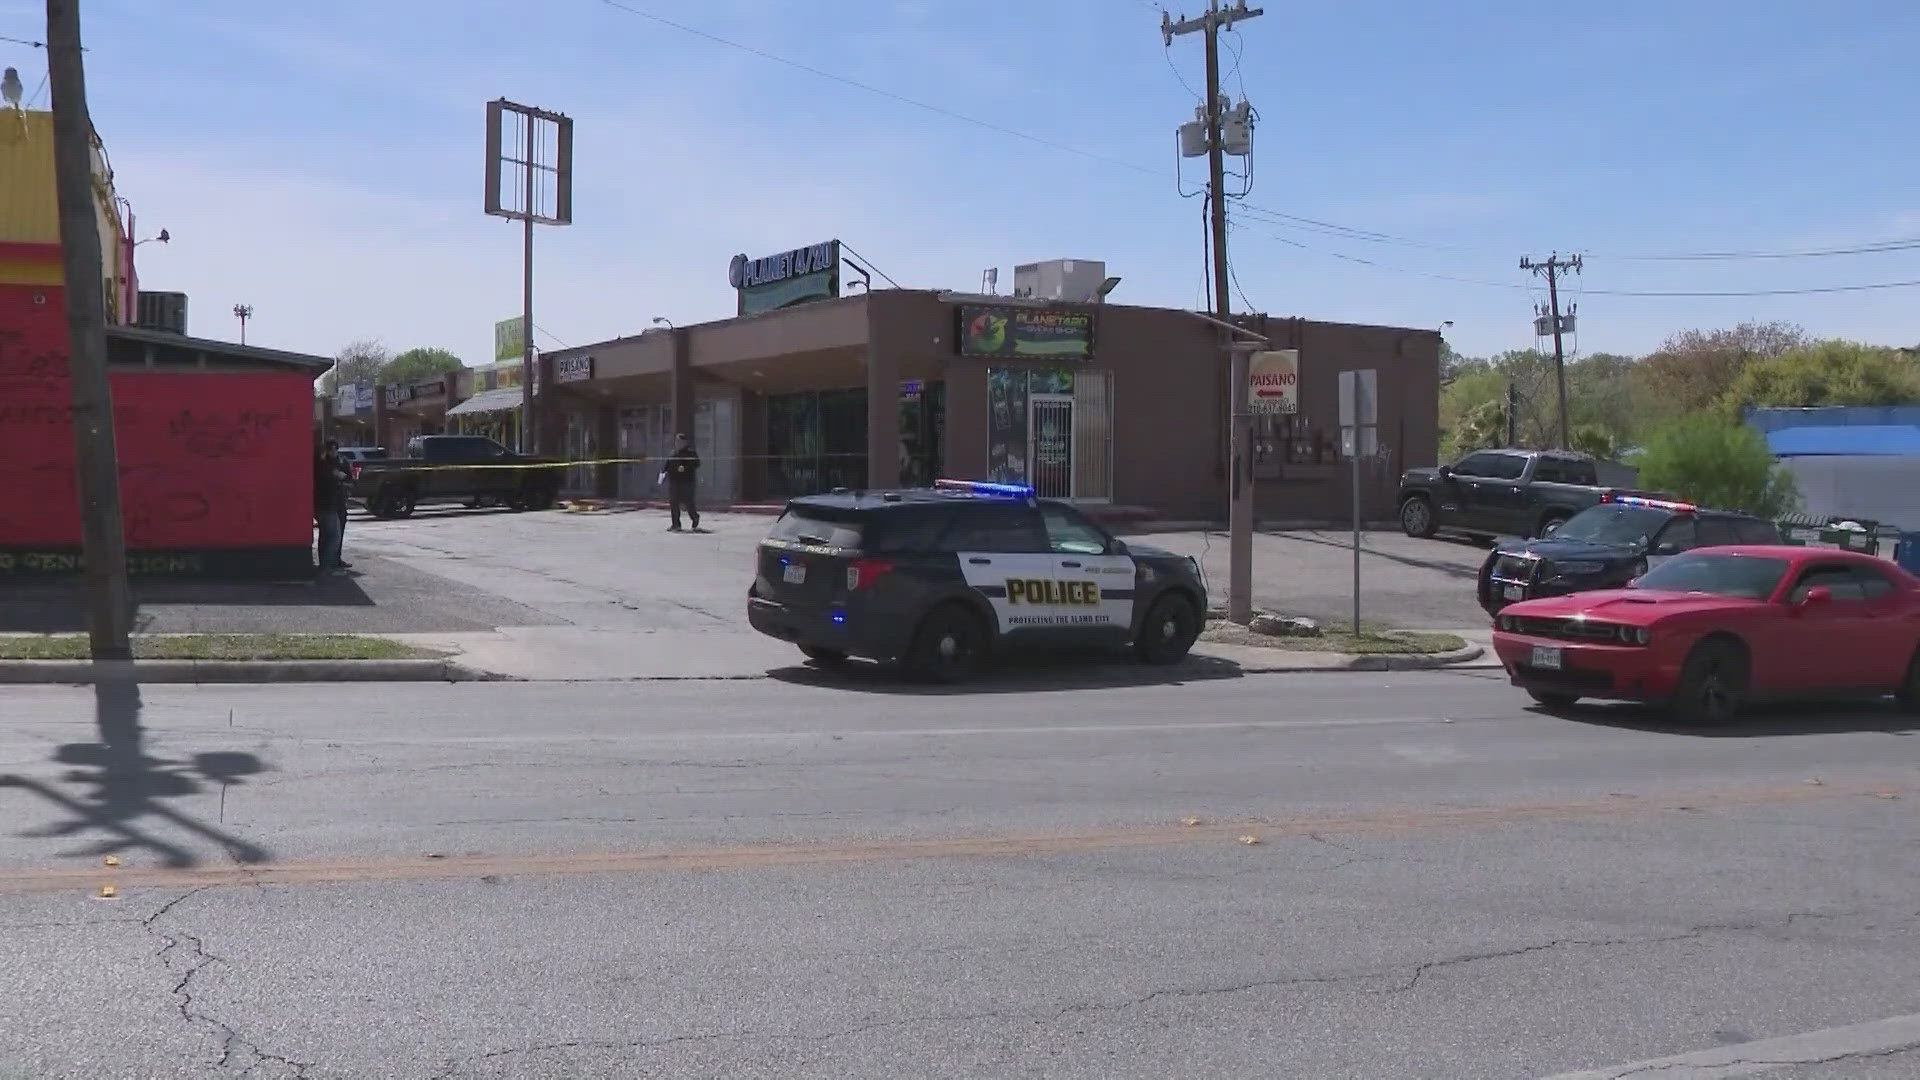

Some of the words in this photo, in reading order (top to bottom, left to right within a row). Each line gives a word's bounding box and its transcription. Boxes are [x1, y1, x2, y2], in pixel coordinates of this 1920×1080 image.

[743, 249, 795, 288] PLANET
[795, 241, 832, 274] 4/20
[1250, 373, 1296, 386] PAISANO
[1006, 579, 1099, 606] POLICE
[1008, 615, 1054, 624] PROTECTING
[1055, 615, 1069, 623] THE
[1071, 615, 1094, 624] ALAMO
[1095, 615, 1110, 623] CITY
